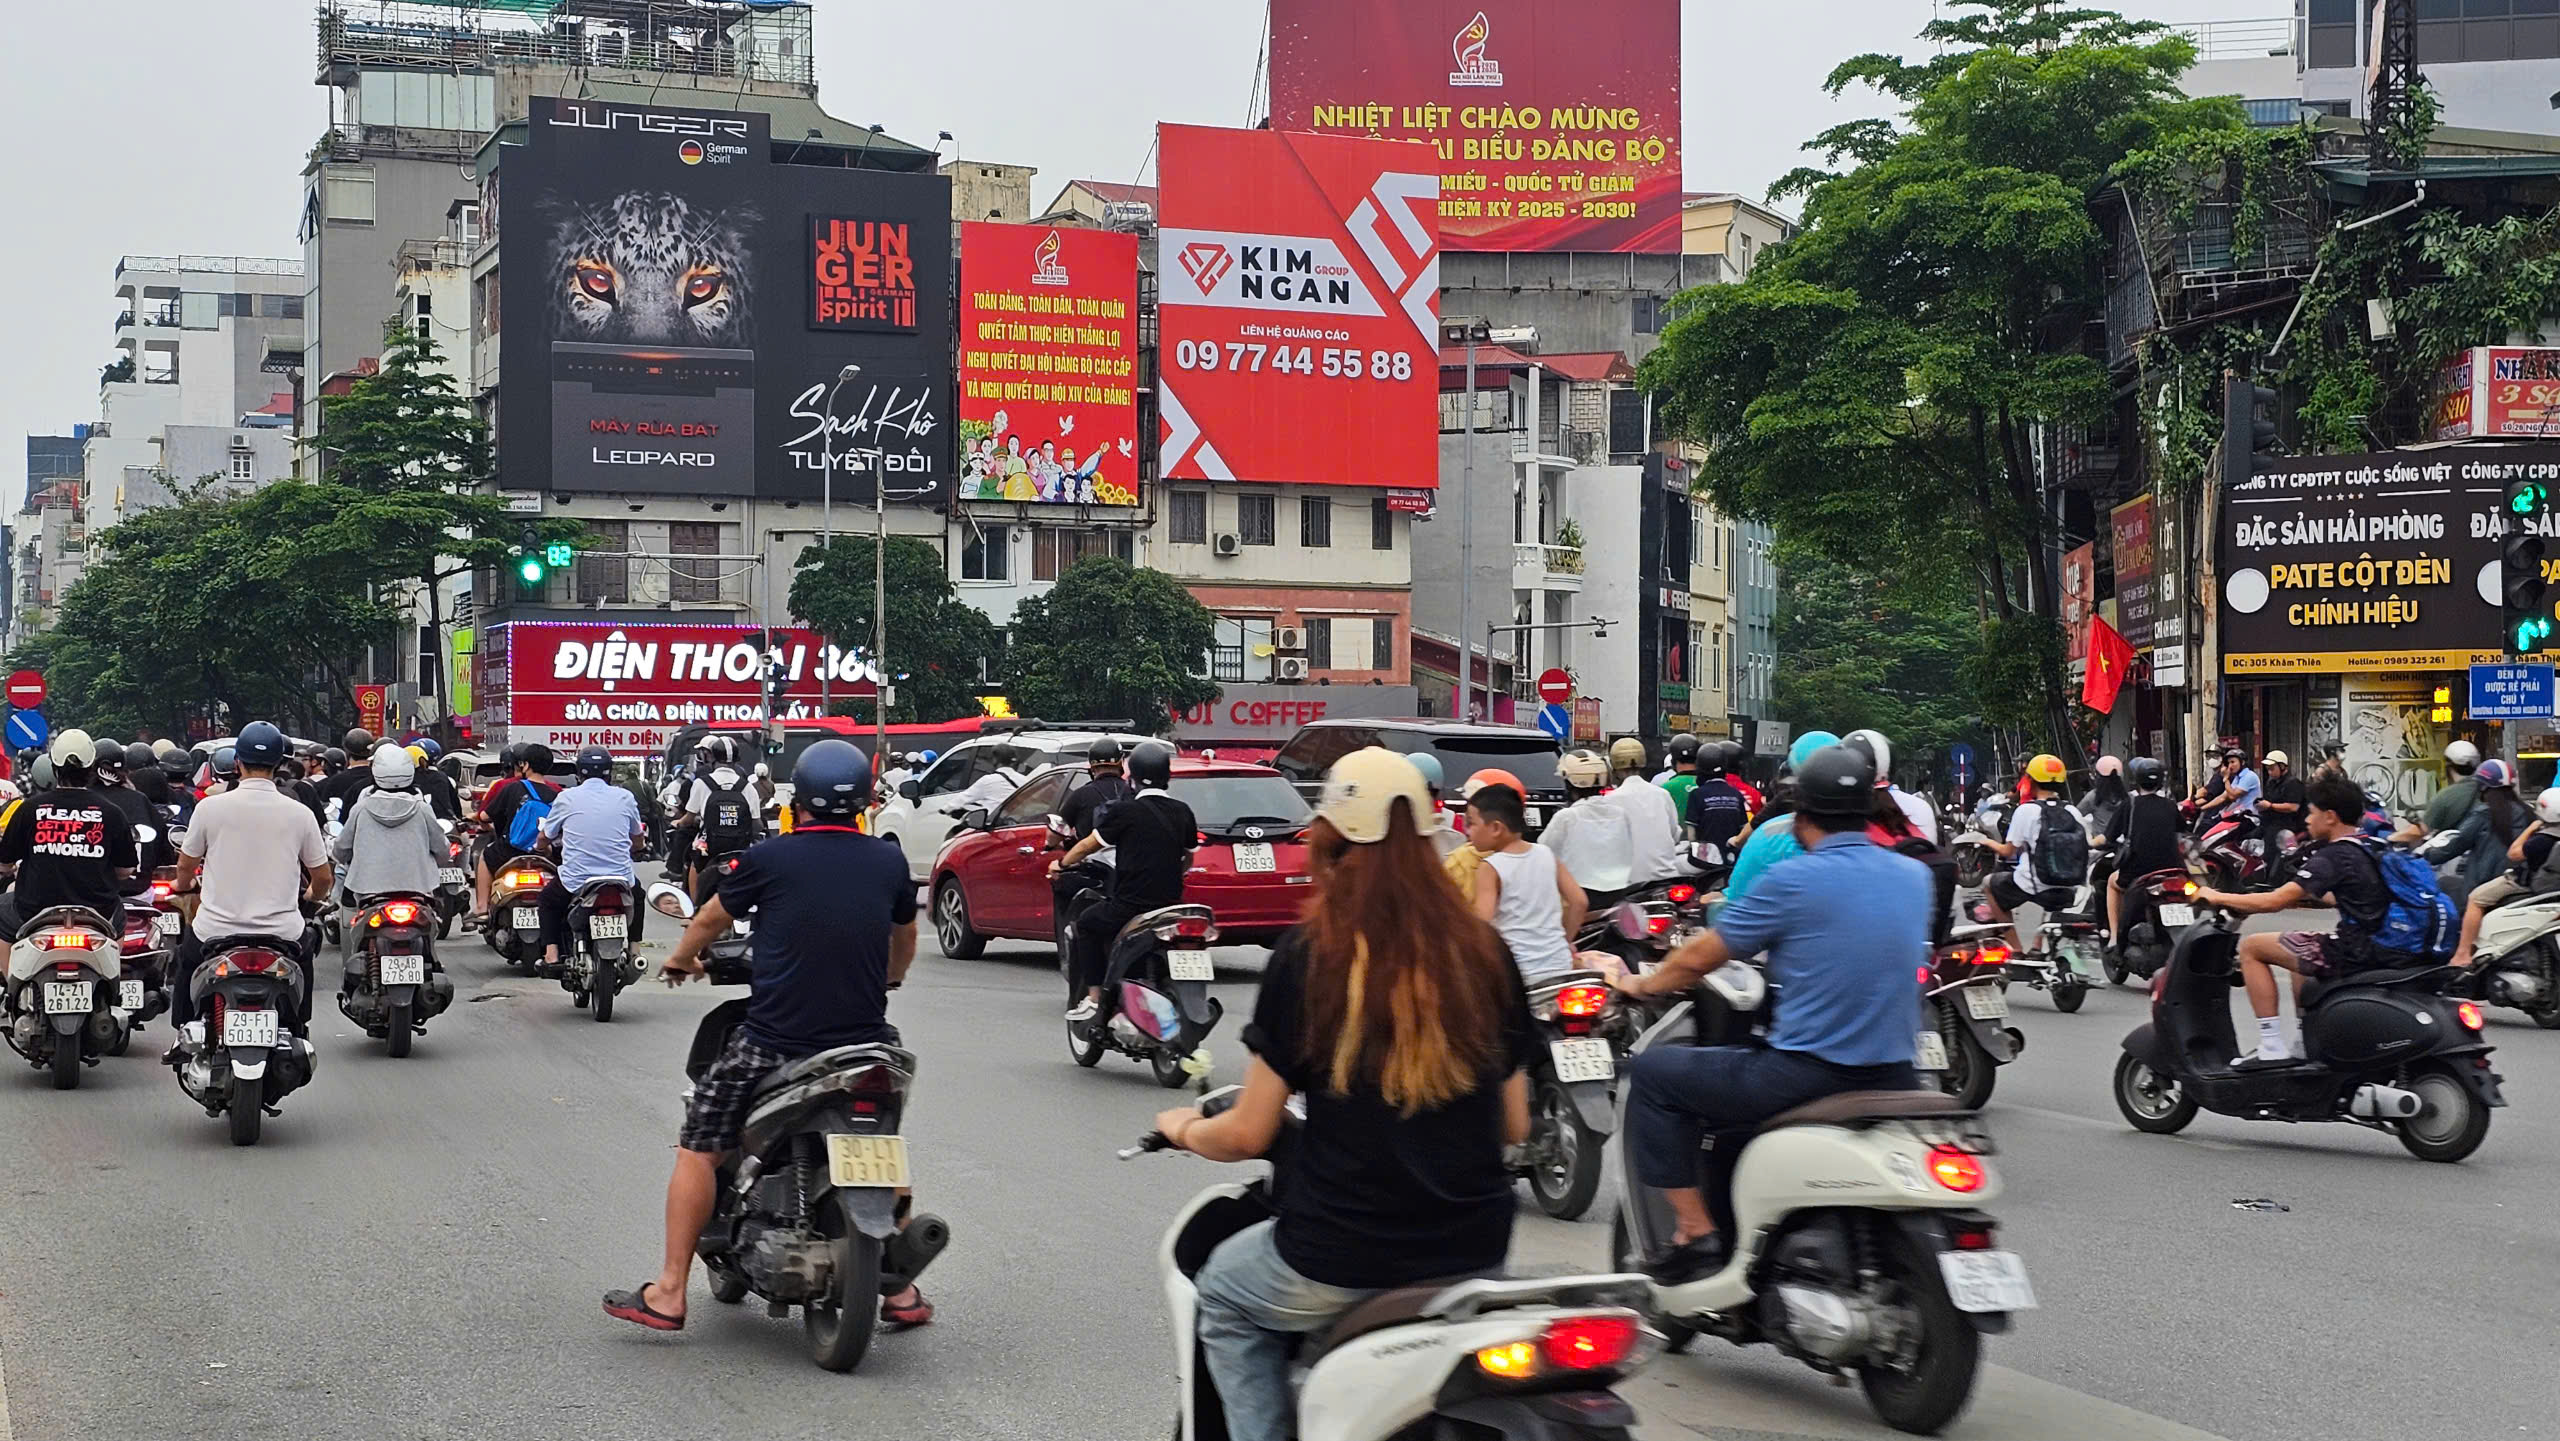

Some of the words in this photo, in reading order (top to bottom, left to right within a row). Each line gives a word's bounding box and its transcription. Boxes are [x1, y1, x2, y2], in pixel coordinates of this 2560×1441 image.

[549, 106, 747, 138] JUNGER
[1313, 102, 1393, 133] NHIỆT
[1402, 102, 1452, 133] LIỆT
[1460, 102, 1541, 130] CHÀO
[1550, 104, 1640, 130] MỪNG
[706, 142, 748, 155] German
[706, 153, 731, 164] Spirit
[1463, 130, 1523, 162] BIỂU
[1531, 132, 1616, 162] ĐẢNG
[1626, 136, 1666, 166] BỘ
[1441, 169, 1487, 192] MIẾU
[1504, 169, 1553, 193] QUỐC
[1558, 170, 1585, 192] TỬ
[1590, 172, 1635, 193] GIÁM
[1438, 200, 1482, 221] HIỆM
[1488, 197, 1510, 219] KỲ
[1517, 201, 1565, 218] 2025
[1582, 201, 1637, 218] 2030!
[816, 219, 908, 257] JUN
[815, 251, 915, 290] GER
[1241, 246, 1312, 275] KIM
[1314, 265, 1350, 277] GROUP
[870, 288, 911, 297] GERMAN
[1241, 275, 1350, 305] NGAN
[819, 296, 888, 323] spirit
[974, 290, 997, 310] TOÀN
[1028, 293, 1051, 313] TOÀN
[1076, 296, 1099, 317] TOÀN
[1101, 299, 1125, 319] QUÂN
[978, 318, 1006, 340] QUYẾT
[1008, 321, 1027, 341] TÂM
[1029, 324, 1052, 346] THỰC
[1053, 324, 1074, 347] HIỆN
[1076, 322, 1105, 346] THẮNG
[1106, 329, 1121, 350] LỢI
[1240, 324, 1264, 336] LIÊN
[1266, 324, 1281, 339] HỆ
[1283, 324, 1323, 340] QUẢNG
[1325, 327, 1350, 341] CÁO
[967, 351, 989, 372] NGHỊ
[990, 348, 1018, 371] QUYẾT
[1020, 353, 1035, 374] ĐẠI
[1037, 352, 1052, 375] HỘI
[1054, 351, 1079, 373] ĐẢNG
[1080, 354, 1093, 378] BỘ
[1094, 356, 1112, 375] CÁC
[1113, 354, 1132, 377] CẤP
[1175, 340, 1219, 371] 09
[1321, 349, 1362, 378] 55
[1370, 351, 1412, 381] 88
[966, 377, 979, 398] VÀ
[980, 381, 1003, 402] NGHỊ
[1004, 378, 1032, 400] QUYẾT
[1033, 384, 1049, 404] ĐẠI
[1051, 382, 1066, 405] HỘI
[1068, 385, 1083, 402] XIV
[1084, 381, 1102, 404] CỦA
[2497, 384, 2521, 405] 3
[778, 382, 869, 447] Sạch
[873, 384, 938, 446] Khô
[592, 446, 715, 466] LEOPARD
[788, 447, 880, 475] TUYỆT
[884, 446, 931, 473] ĐỐI
[2269, 474, 2287, 488] TY
[2290, 470, 2342, 488] CPĐTPT
[2345, 466, 2381, 488] CUỘC
[2383, 461, 2420, 483] SỐNG
[2421, 462, 2453, 484] VIỆT
[2461, 461, 2502, 479] CÔNG
[2235, 515, 2278, 552] ĐẶC
[2280, 510, 2325, 546] SẢN
[2327, 508, 2366, 543] HẢI
[2368, 508, 2445, 541] PHÒNG
[2270, 562, 2335, 590] PATE
[2337, 551, 2393, 593] CỘT
[2395, 551, 2451, 586] ĐÈN
[2288, 597, 2360, 626] CHÍNH
[2363, 593, 2419, 629] HIỆU
[553, 630, 662, 691] ĐIỆN
[2249, 657, 2268, 667] 305
[2269, 656, 2296, 667] Khâm
[2299, 656, 2322, 667] Thiên
[2348, 656, 2382, 667] Hotline:
[2383, 655, 2409, 666] 0989
[2410, 655, 2427, 666] 325
[2429, 655, 2446, 665] 261
[2497, 666, 2514, 679] ĐÈN
[2484, 680, 2506, 694] ĐƯỢC
[2520, 677, 2540, 692] PHẢI
[2500, 691, 2517, 705] CHÚ
[564, 700, 601, 721] SỬA
[606, 701, 660, 721] CHỮA
[664, 701, 710, 724] ĐIỆN
[549, 732, 583, 751] PHỤ
[588, 729, 624, 751] KIỆN
[628, 729, 664, 751] ĐIỆN
[35, 807, 103, 823] PLEASE
[36, 821, 64, 830] GET
[34, 831, 69, 844] OUT
[69, 833, 86, 843] OF
[33, 845, 47, 854] MY
[47, 842, 105, 858] WORLD
[52, 984, 85, 997] 14-Z1
[48, 997, 90, 1011] 261.22
[232, 1013, 270, 1027] 29-F1
[227, 1029, 274, 1044] 503.13
